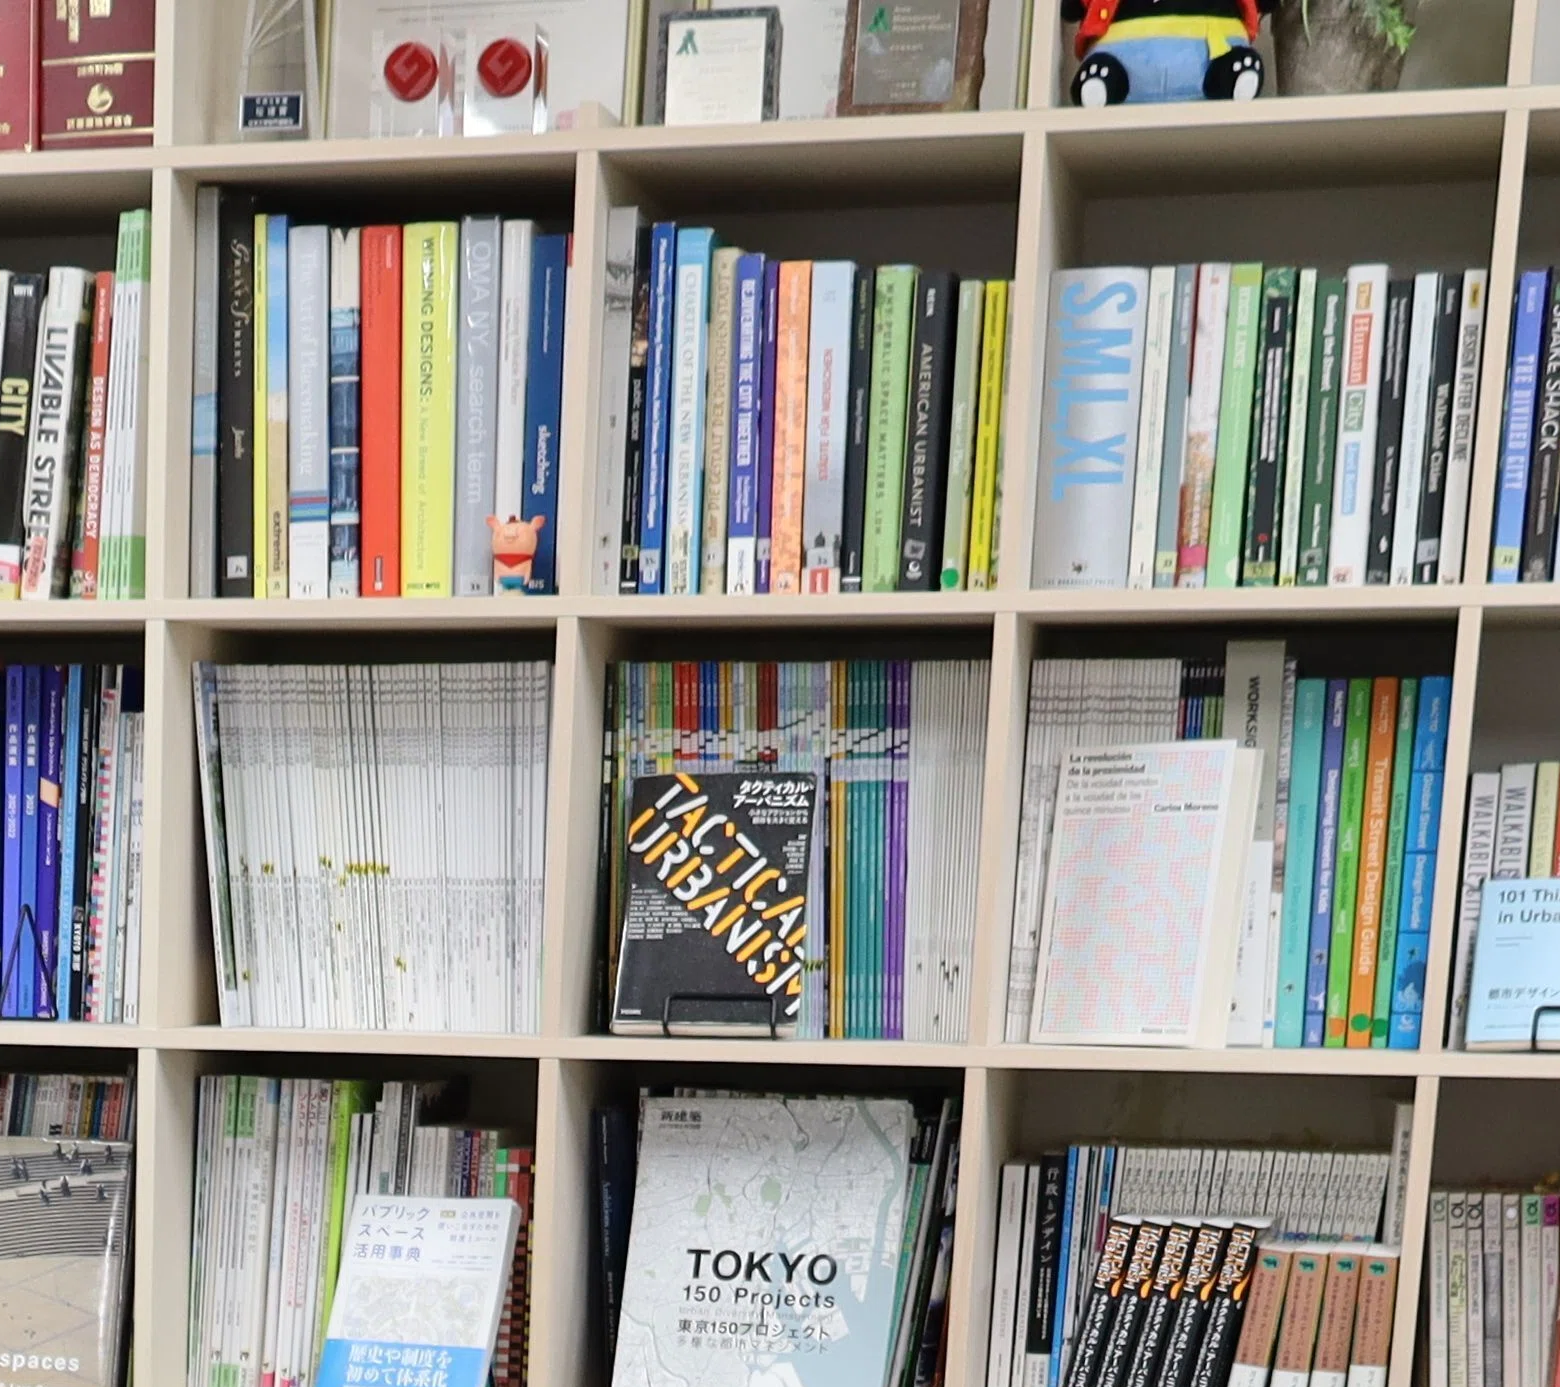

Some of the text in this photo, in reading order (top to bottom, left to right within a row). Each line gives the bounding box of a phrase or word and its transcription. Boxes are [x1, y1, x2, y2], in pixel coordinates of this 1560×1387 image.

[1348, 314, 1372, 384] Human
[36, 326, 69, 444] LIVABLE
[1431, 383, 1449, 448] Walkable
[908, 342, 932, 527] AMERICAN URBANIST
[85, 376, 104, 539] DESIGN AS DEMOCRACY
[1069, 752, 1132, 763] La revolución
[1068, 764, 1146, 775] de proximidad
[732, 794, 809, 808] アーバニズム
[1324, 768, 1338, 826] Designing
[1152, 802, 1219, 813] Carlos Moreno
[1418, 772, 1435, 849] Global Street
[1356, 759, 1389, 974] Transit Street Design Guide
[1408, 854, 1427, 929] Design Guide
[1498, 889, 1526, 903] 101
[1498, 911, 1514, 925] in
[1489, 987, 1560, 999] 都市デザイン
[660, 1110, 702, 1122] 新建築
[362, 1204, 431, 1222] パブリック
[358, 1224, 425, 1241] スペース
[352, 1244, 422, 1262] 活用事典
[686, 1248, 837, 1286] TOKYO
[683, 1285, 836, 1309] 150 Projects
[677, 1319, 830, 1339] 東京150プロジェクト
[0, 1352, 80, 1372] spaces
[348, 1345, 453, 1369] 歴史や制度を
